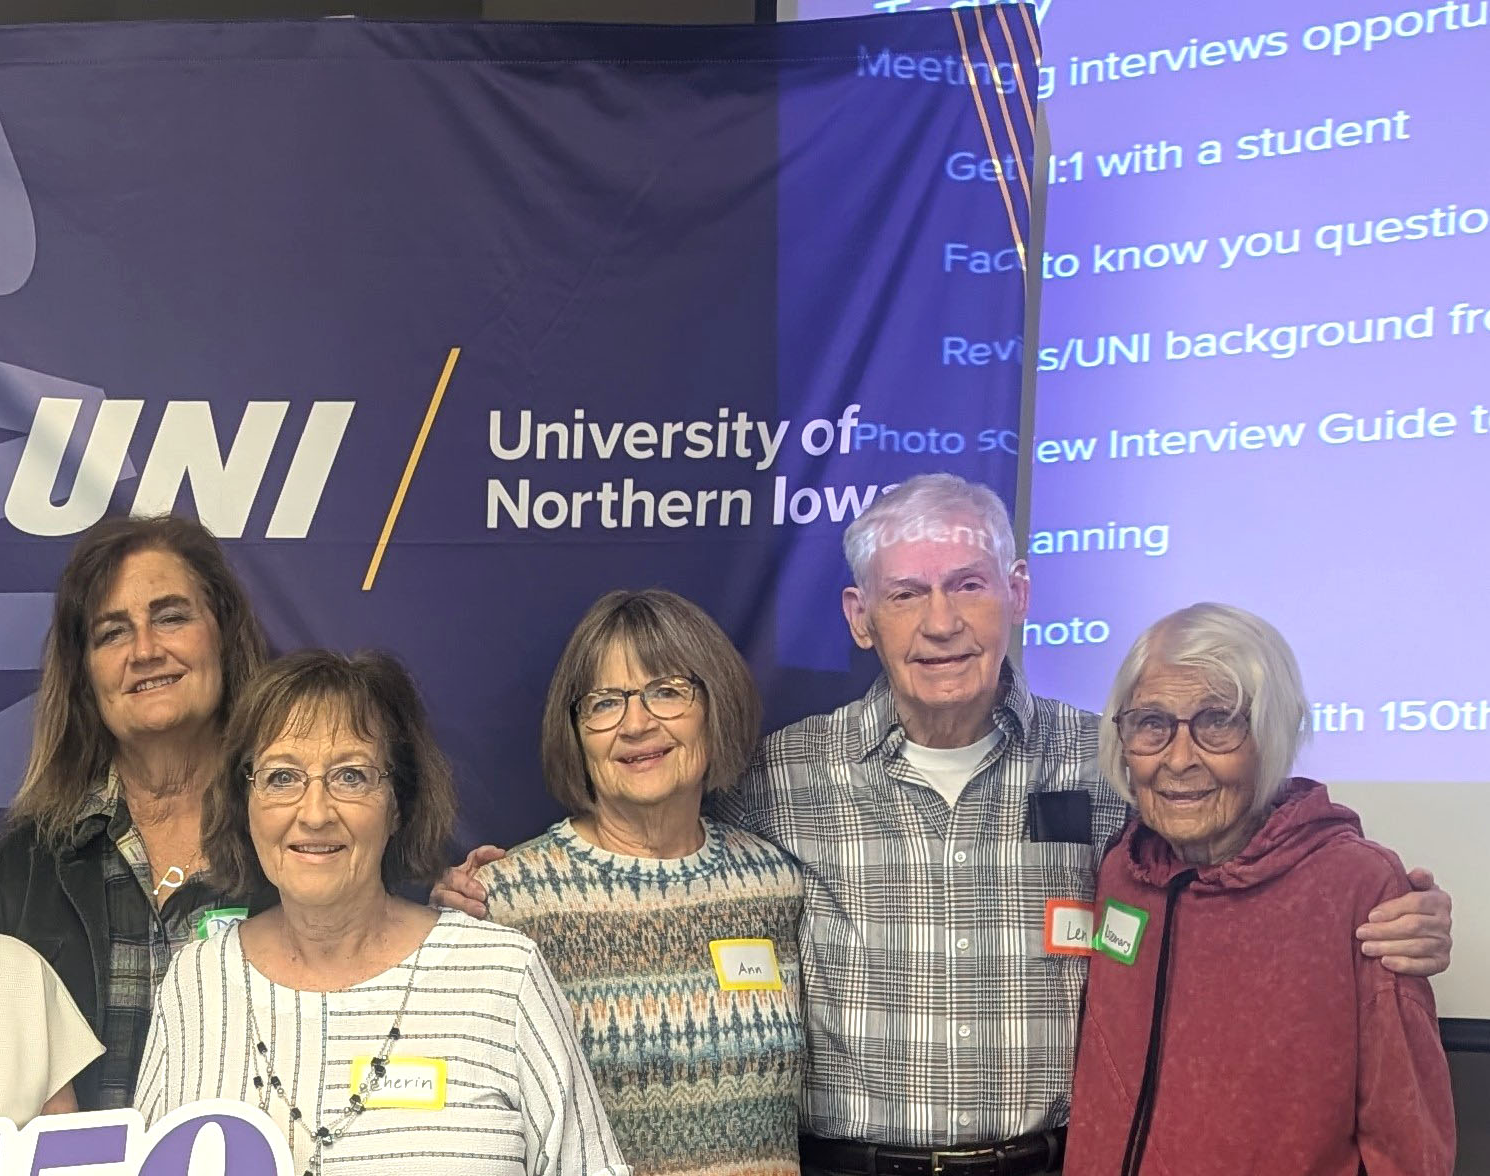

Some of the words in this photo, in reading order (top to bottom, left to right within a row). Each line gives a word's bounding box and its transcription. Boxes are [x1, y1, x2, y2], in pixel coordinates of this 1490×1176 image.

[857, 47, 1017, 94] Meeting
[1069, 27, 1287, 86] interviews
[946, 151, 1018, 182] Get
[1096, 140, 1183, 178] with
[1197, 140, 1222, 165] a
[1236, 110, 1410, 160] student
[944, 243, 1024, 273] Fac
[1042, 251, 1079, 279] to
[1093, 240, 1207, 274] know
[1218, 228, 1300, 268] you
[1037, 333, 1150, 371] s/UNI
[1166, 305, 1434, 360] background
[489, 406, 790, 470] University
[801, 404, 861, 456] of
[855, 422, 965, 455] Photo
[1035, 437, 1097, 463] ew
[1109, 416, 1306, 459] Interview
[1318, 407, 1457, 444] Guide
[4, 397, 356, 539] UNI
[486, 478, 752, 529] Northern
[773, 475, 900, 526] Iow
[1029, 521, 1169, 556] anning
[1022, 617, 1110, 646] hoto
[738, 961, 763, 976] Ann
